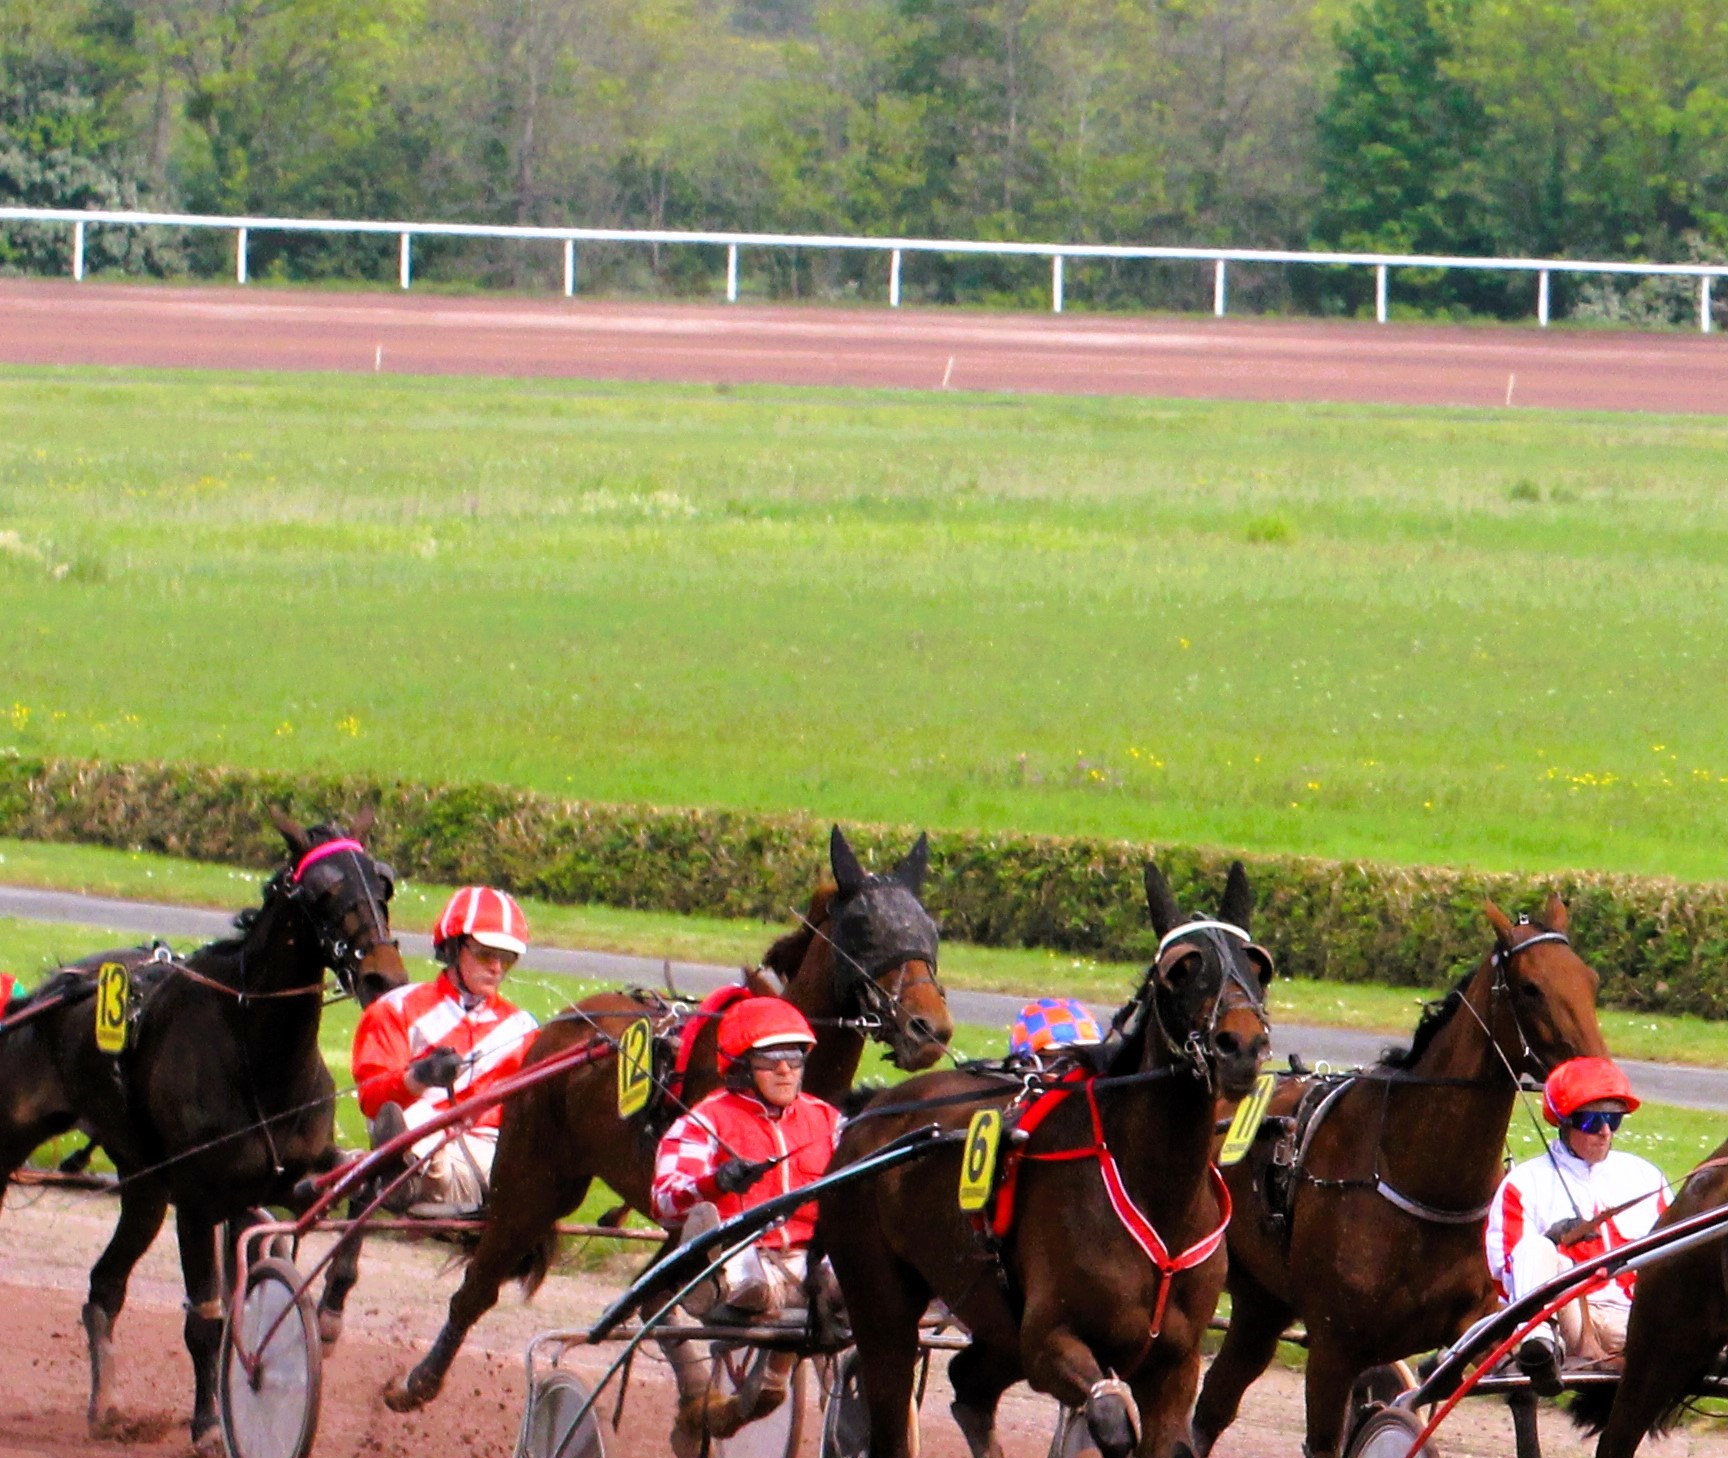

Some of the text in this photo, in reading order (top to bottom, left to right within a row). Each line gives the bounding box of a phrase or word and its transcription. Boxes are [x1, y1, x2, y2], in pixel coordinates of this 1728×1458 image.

[101, 968, 125, 1028] 13
[622, 1022, 649, 1093] 12
[968, 1113, 992, 1183] 6
